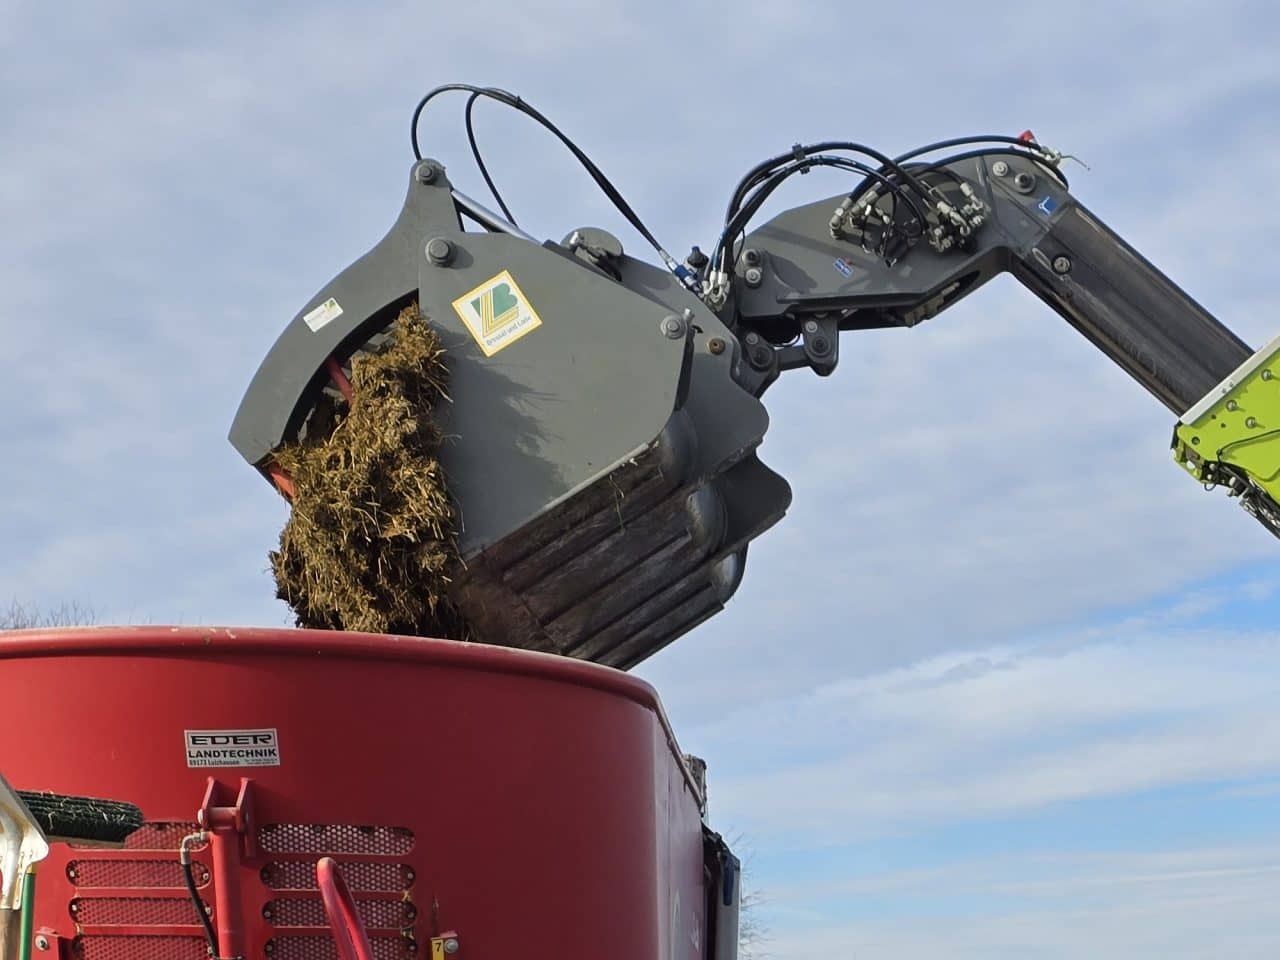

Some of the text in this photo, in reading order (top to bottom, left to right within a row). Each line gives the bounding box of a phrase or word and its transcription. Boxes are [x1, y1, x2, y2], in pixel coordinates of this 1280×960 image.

[190, 734, 272, 745] EDER
[188, 748, 278, 758] LANDTECHNIK
[435, 942, 442, 952] 7
